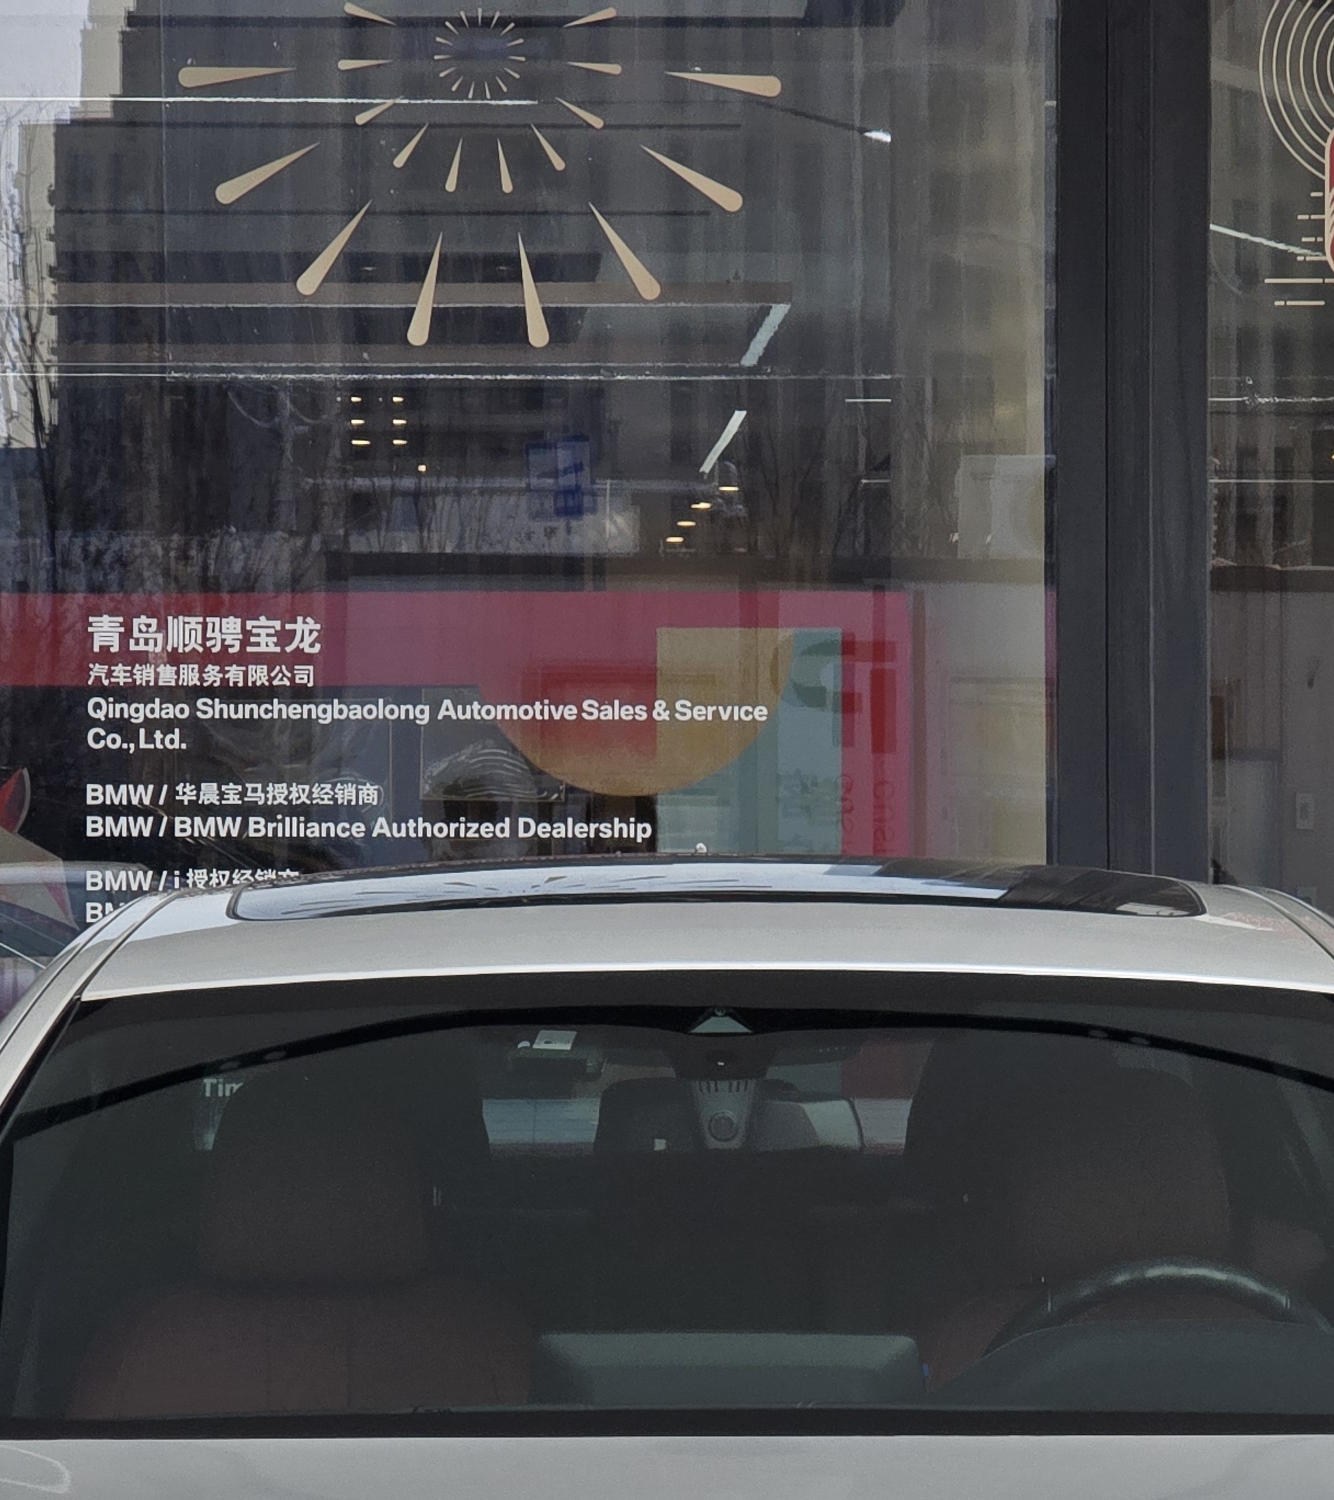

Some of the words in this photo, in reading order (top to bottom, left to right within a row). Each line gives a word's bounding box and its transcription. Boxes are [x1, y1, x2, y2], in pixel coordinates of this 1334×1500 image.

[87, 615, 321, 653] 青岛顺骋宝龙
[87, 663, 315, 687] 汽车销售服务有限公司
[87, 697, 189, 723] Qingdao
[196, 697, 430, 724] Shunchengbaolong
[437, 699, 577, 721] Automotive
[581, 700, 647, 721] Sales
[652, 701, 670, 721] &
[674, 700, 768, 721] Service
[139, 728, 187, 749] Ltd.
[86, 784, 154, 805] BMW
[175, 783, 379, 805] 华晨宝马授权经销商
[86, 816, 154, 837] BMW
[174, 816, 242, 837] BMW
[248, 814, 365, 837] Brilliance
[372, 817, 510, 839] Authorized
[518, 817, 652, 842] Dealership
[86, 870, 152, 891] BMW
